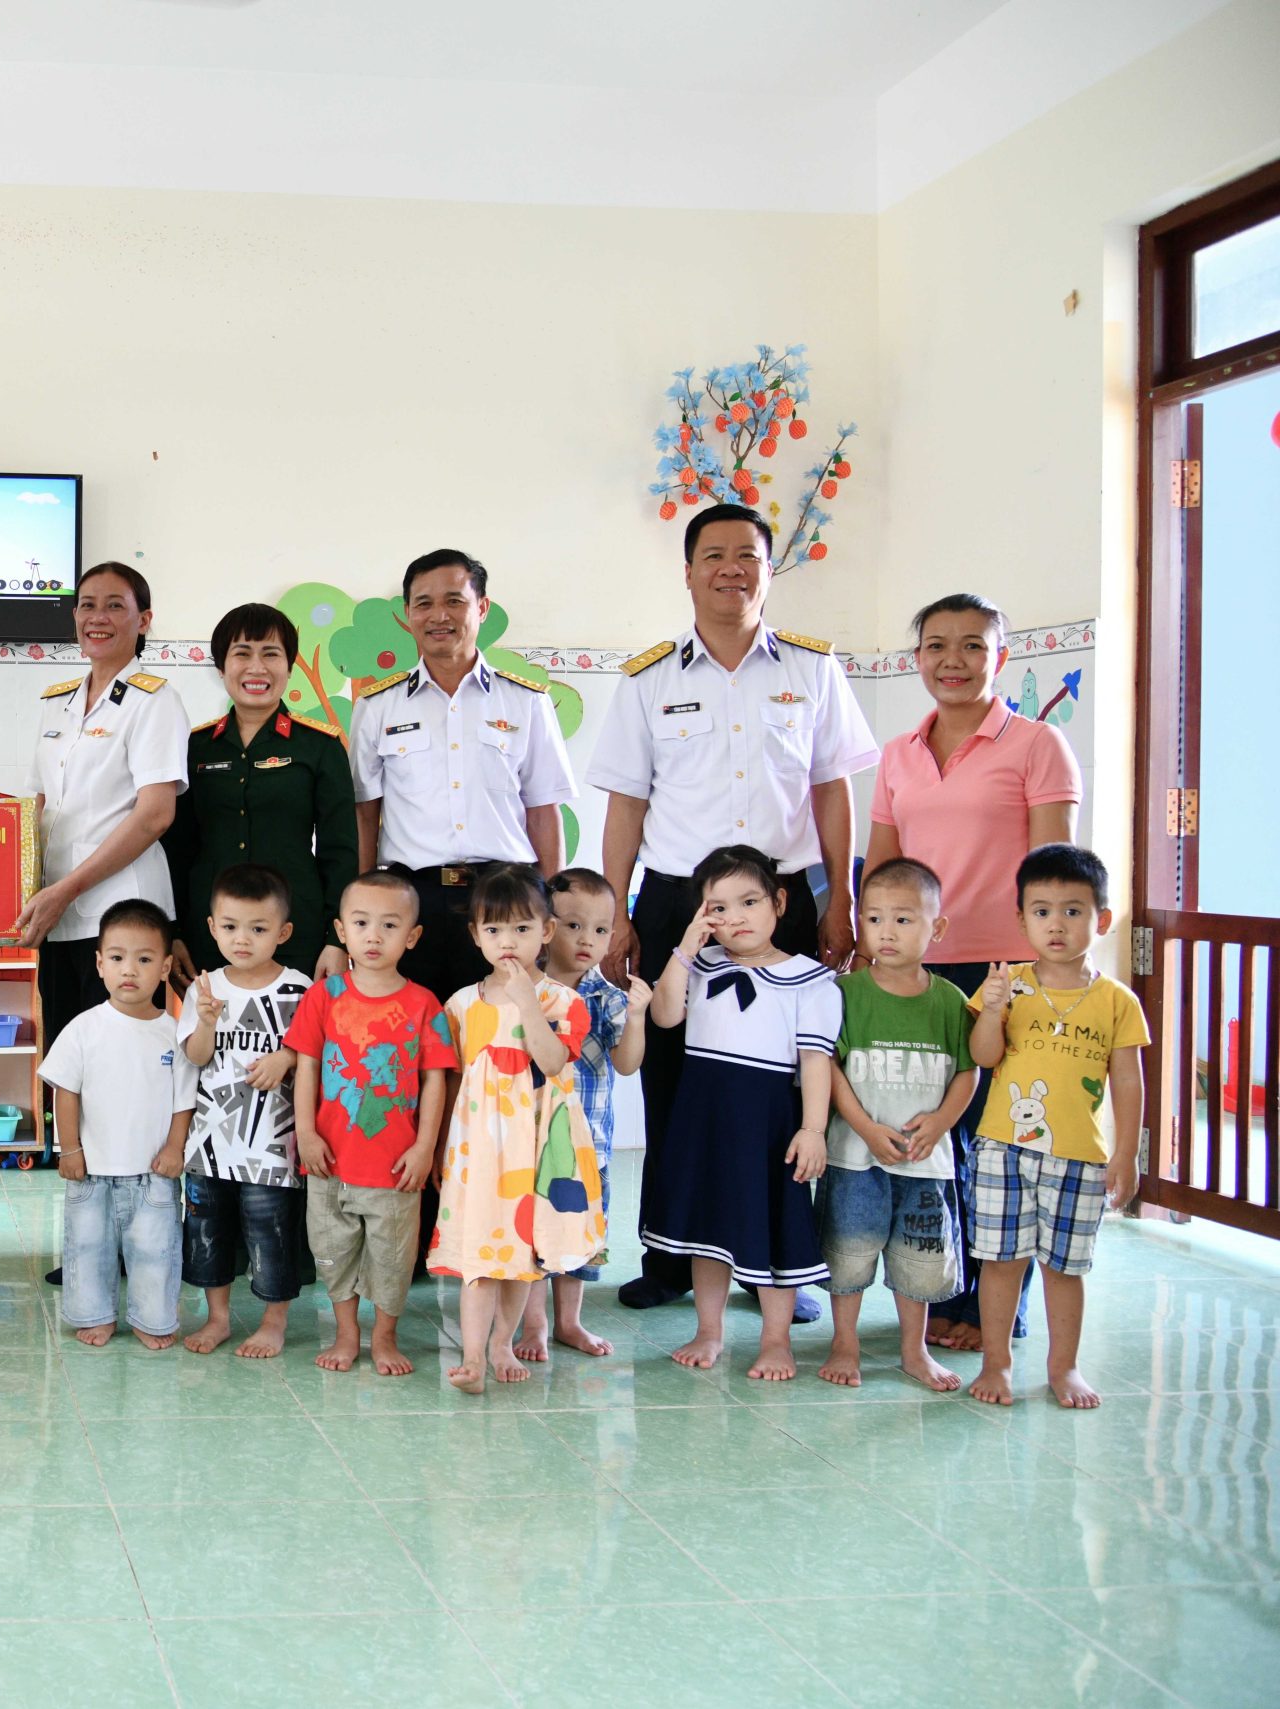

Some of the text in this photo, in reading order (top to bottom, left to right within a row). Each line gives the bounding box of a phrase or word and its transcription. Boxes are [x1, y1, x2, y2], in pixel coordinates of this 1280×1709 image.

[1024, 1039, 1045, 1050] TO
[1052, 1042, 1080, 1058] THE
[850, 1049, 946, 1085] DREAM
